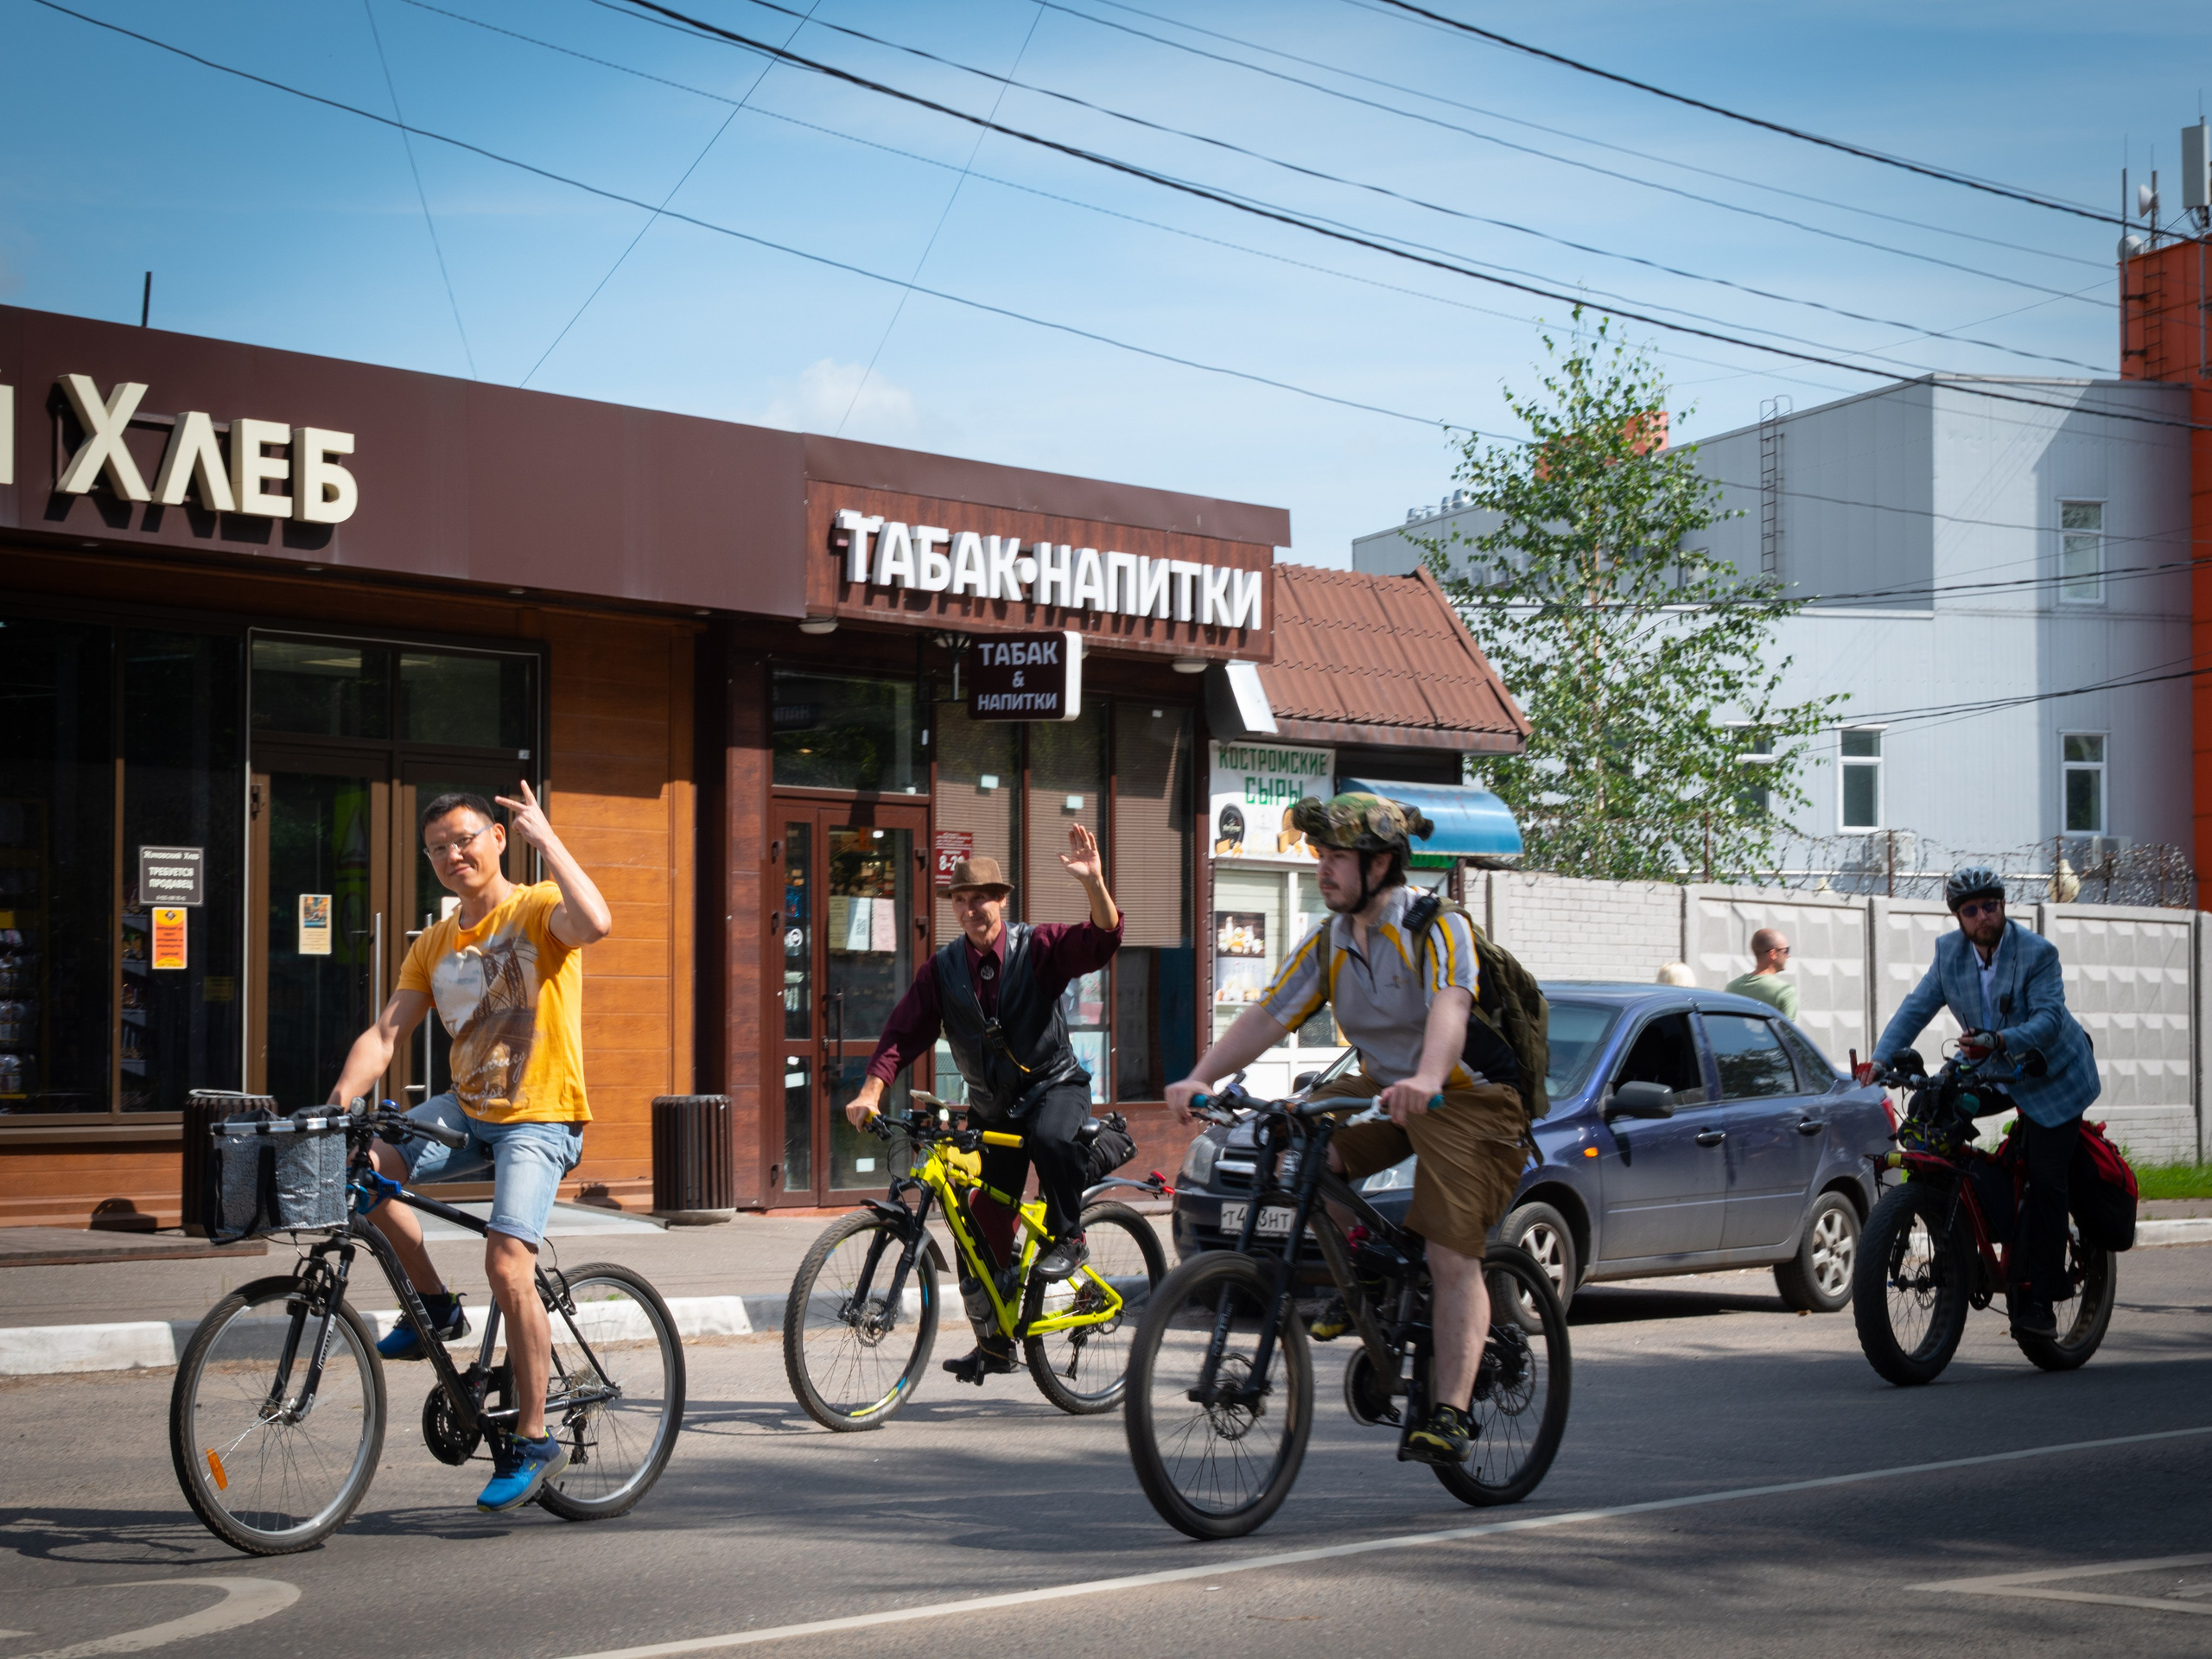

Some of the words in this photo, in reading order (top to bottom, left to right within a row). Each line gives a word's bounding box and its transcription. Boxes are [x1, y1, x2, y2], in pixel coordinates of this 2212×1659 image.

[54, 373, 359, 524] ХЛЕБ
[977, 640, 1059, 666] ТАБАК
[1012, 670, 1026, 689] &
[977, 692, 1058, 711] НАПИТКИ
[1217, 746, 1328, 777] КОСТРОМСКИЕ
[1245, 776, 1304, 808] СЫРЫ
